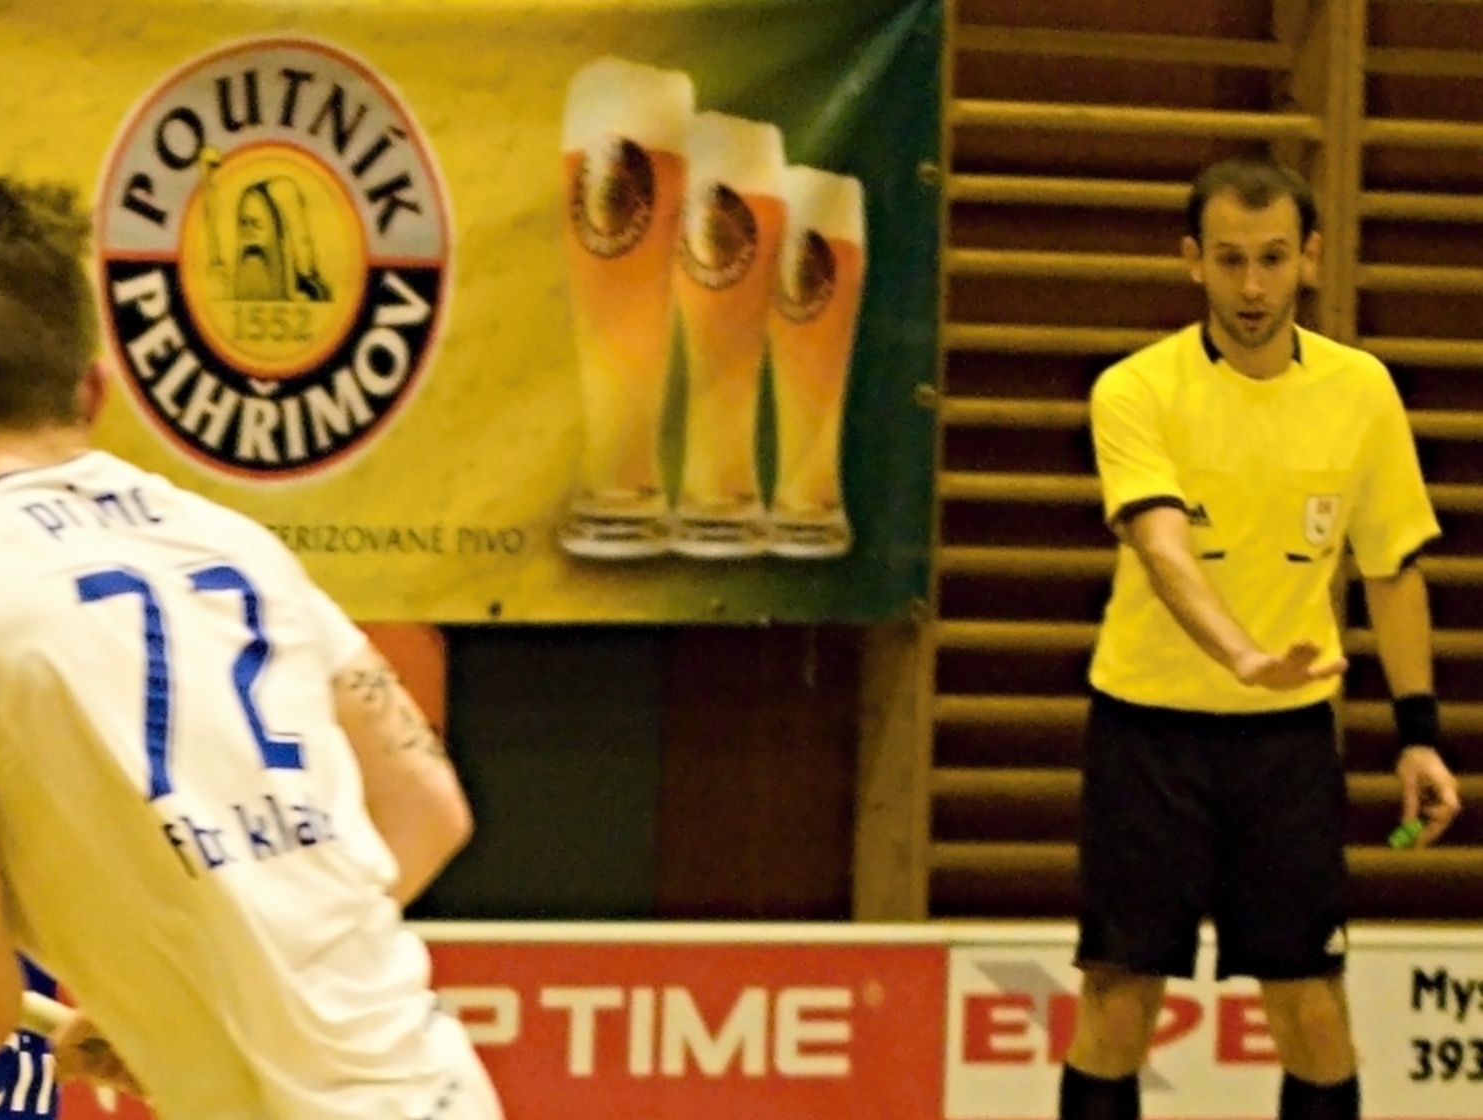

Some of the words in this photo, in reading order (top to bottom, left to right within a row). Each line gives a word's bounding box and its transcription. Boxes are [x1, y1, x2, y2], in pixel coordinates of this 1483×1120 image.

[119, 68, 422, 234] POUTNÍK
[113, 269, 433, 463] PELHŘIMOV
[231, 305, 314, 343] 1552
[457, 525, 525, 555] PIVO
[75, 564, 306, 801] 72
[540, 987, 853, 1079] TIME
